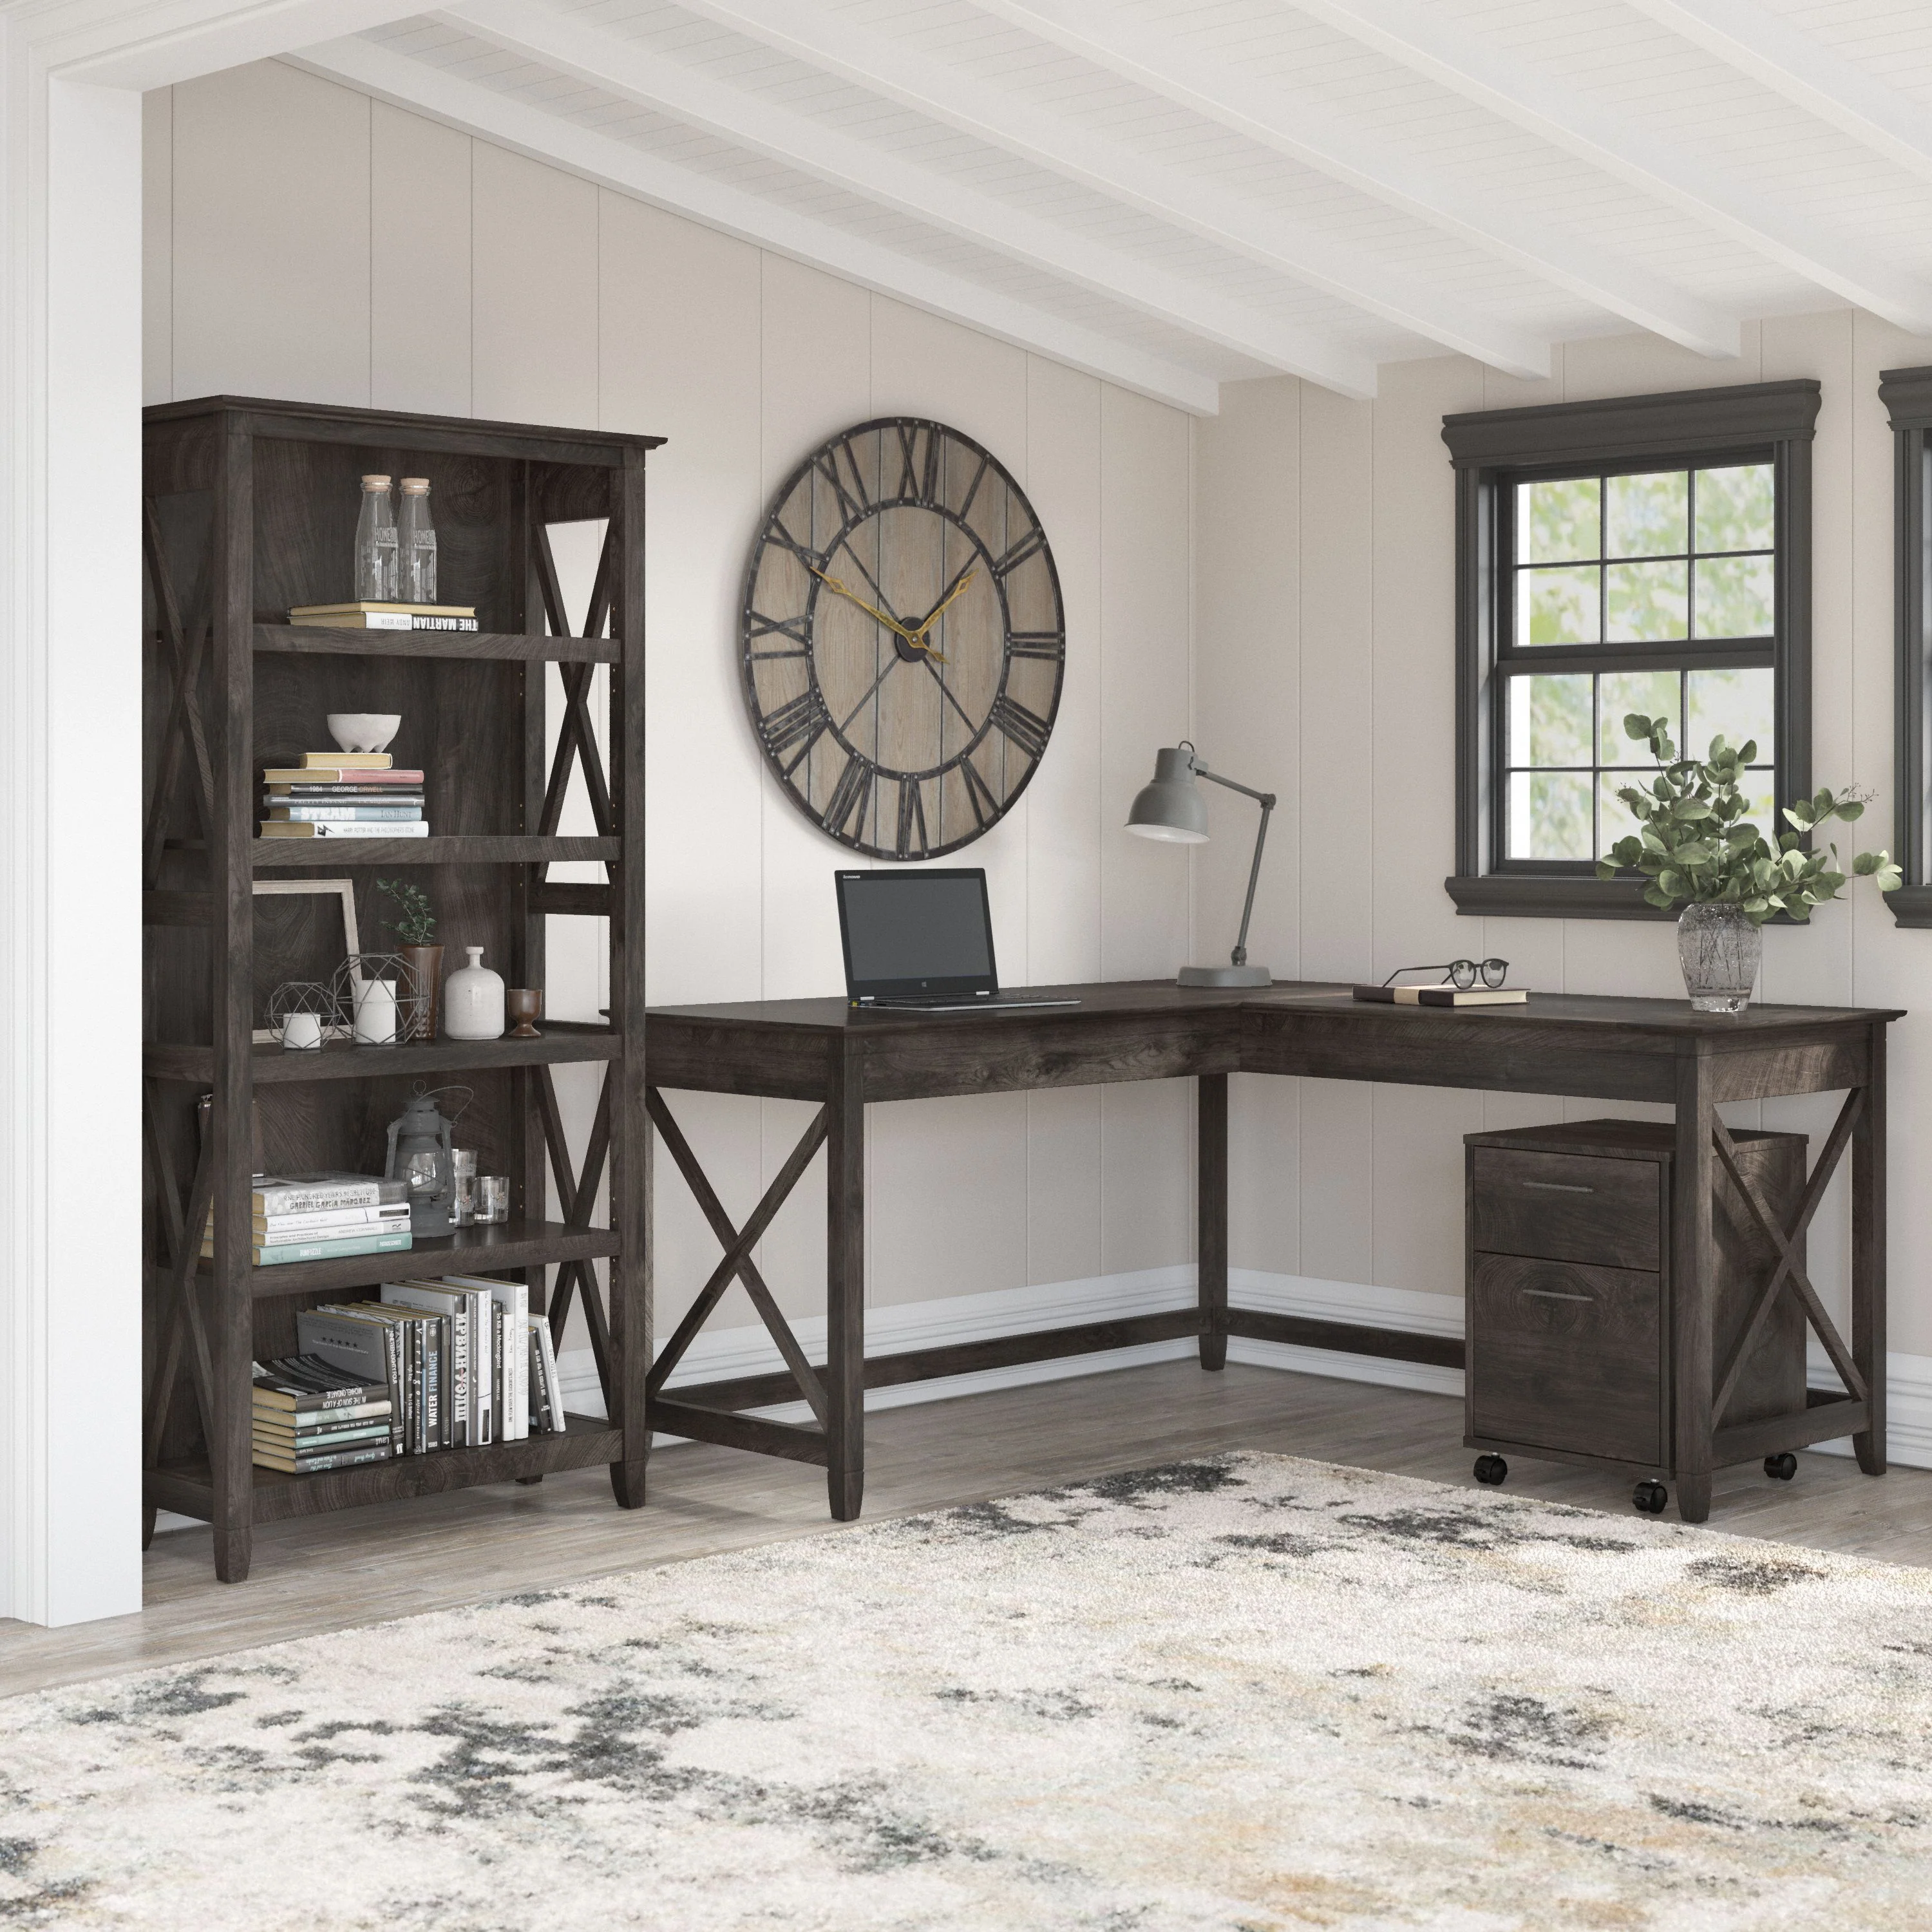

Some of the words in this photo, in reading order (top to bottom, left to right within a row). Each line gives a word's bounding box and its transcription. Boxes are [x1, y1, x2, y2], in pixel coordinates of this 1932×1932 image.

[413, 617, 457, 630] MARTIAN
[459, 619, 478, 631] THE
[290, 1201, 314, 1209] GABRIEL
[413, 1328, 422, 1396] Vertigo
[429, 1350, 437, 1392] FINANCE
[346, 1387, 363, 1396] MICHAEL
[323, 1401, 332, 1409] LION
[343, 1397, 353, 1406] SKIN
[429, 1394, 437, 1427] WATER
